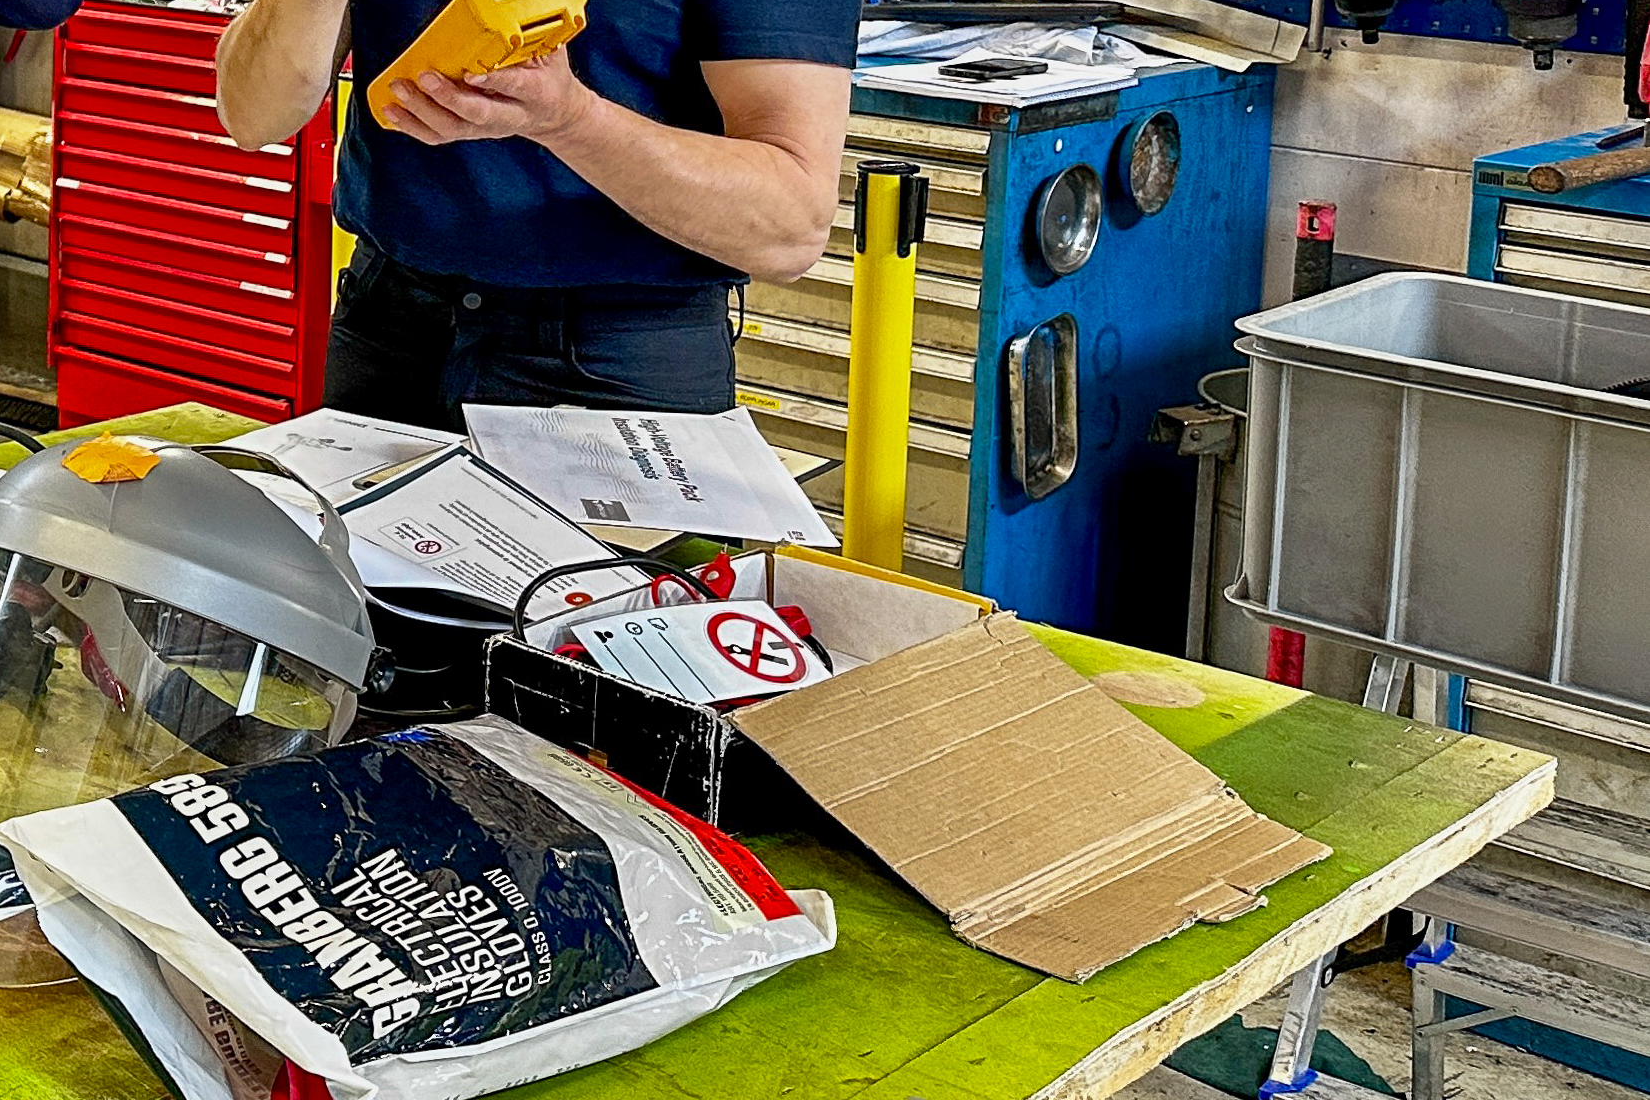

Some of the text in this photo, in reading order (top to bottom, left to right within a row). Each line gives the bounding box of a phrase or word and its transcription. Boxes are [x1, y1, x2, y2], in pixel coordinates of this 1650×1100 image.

[662, 457, 690, 483] Battery
[148, 773, 421, 1040] GRANBERG 589
[330, 867, 469, 1015] ELECTRICAL
[360, 848, 504, 1005] INSULATION
[444, 884, 533, 998] GLOVES
[482, 867, 530, 913] 1000V
[531, 931, 552, 986] CLASS
